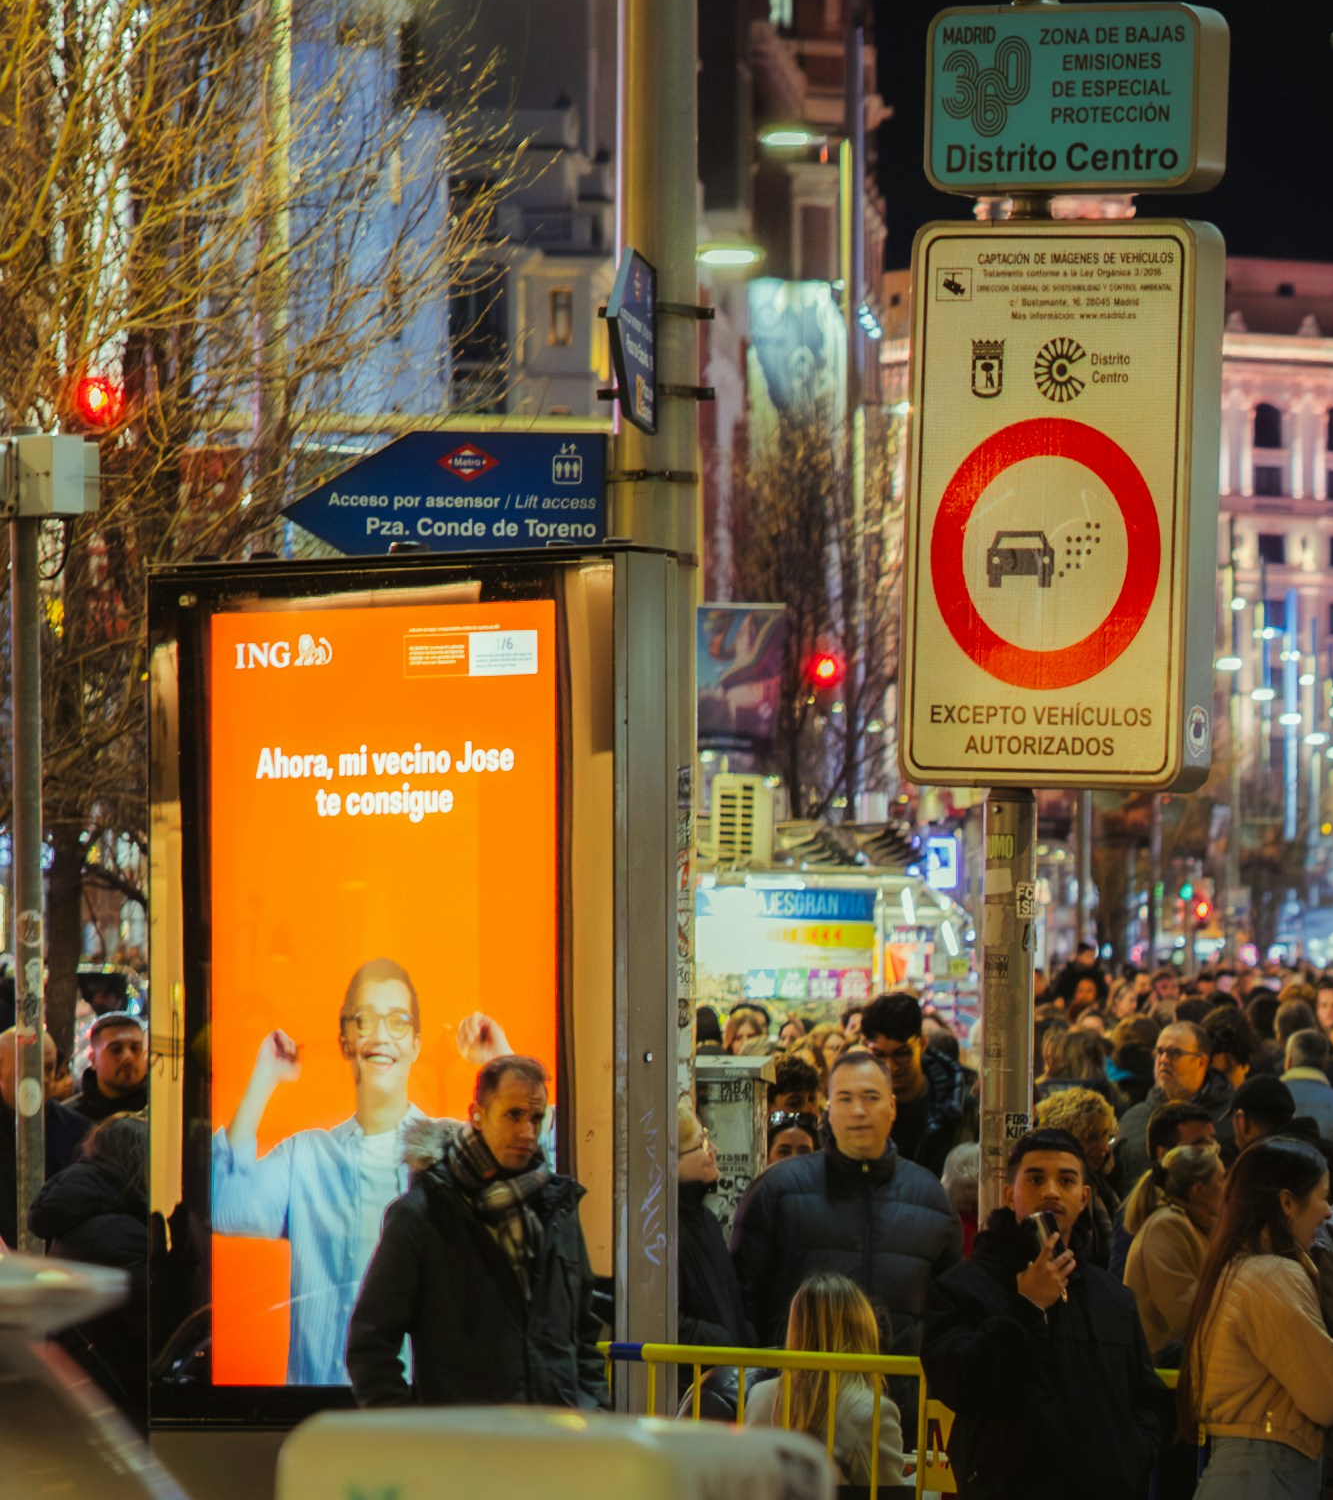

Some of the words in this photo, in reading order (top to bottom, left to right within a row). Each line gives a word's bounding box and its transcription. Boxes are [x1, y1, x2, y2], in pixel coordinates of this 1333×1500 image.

[942, 26, 996, 45] MADRID
[1039, 28, 1090, 46] ZONA
[1095, 27, 1119, 44] DE
[1125, 25, 1186, 44] BAJAS
[1062, 52, 1162, 72] EMISIONES
[1052, 80, 1076, 98] DE
[1082, 79, 1172, 98] ESPECIAL
[1051, 102, 1171, 125] PROTECCIÓN
[946, 143, 1057, 174] Distrito
[1065, 141, 1179, 172] Centro
[977, 251, 1030, 264] CAPTACIÓN
[1033, 253, 1047, 264] DE
[1050, 250, 1099, 264] IMÁGENES
[1103, 253, 1116, 263] DE
[1120, 249, 1174, 264] VEHÍCULOS
[1080, 269, 1093, 278] Ley
[1097, 268, 1131, 278] Orgánica
[1114, 297, 1139, 306] Madrid
[1090, 353, 1131, 366] Distrito
[1091, 370, 1129, 383] Centro
[453, 457, 482, 467] Metro
[328, 492, 389, 508] Acceso
[393, 495, 421, 511] por
[425, 494, 501, 509] ascensor
[515, 494, 539, 509] Lift
[541, 496, 597, 510] access
[365, 517, 411, 537] Pza.
[416, 517, 487, 537] Conde
[492, 518, 518, 537] de
[524, 518, 597, 538] Toreno
[234, 641, 292, 669] ING
[930, 704, 1027, 725] EXCEPTO
[1032, 701, 1152, 728] VEHÍCULOS
[964, 734, 1115, 757] AUTORIZADOS
[255, 745, 334, 781] Ahora,
[338, 744, 369, 778] mi
[371, 743, 452, 777] vecino
[455, 740, 515, 774] Jose
[315, 788, 342, 817] te
[345, 781, 455, 824] consigue
